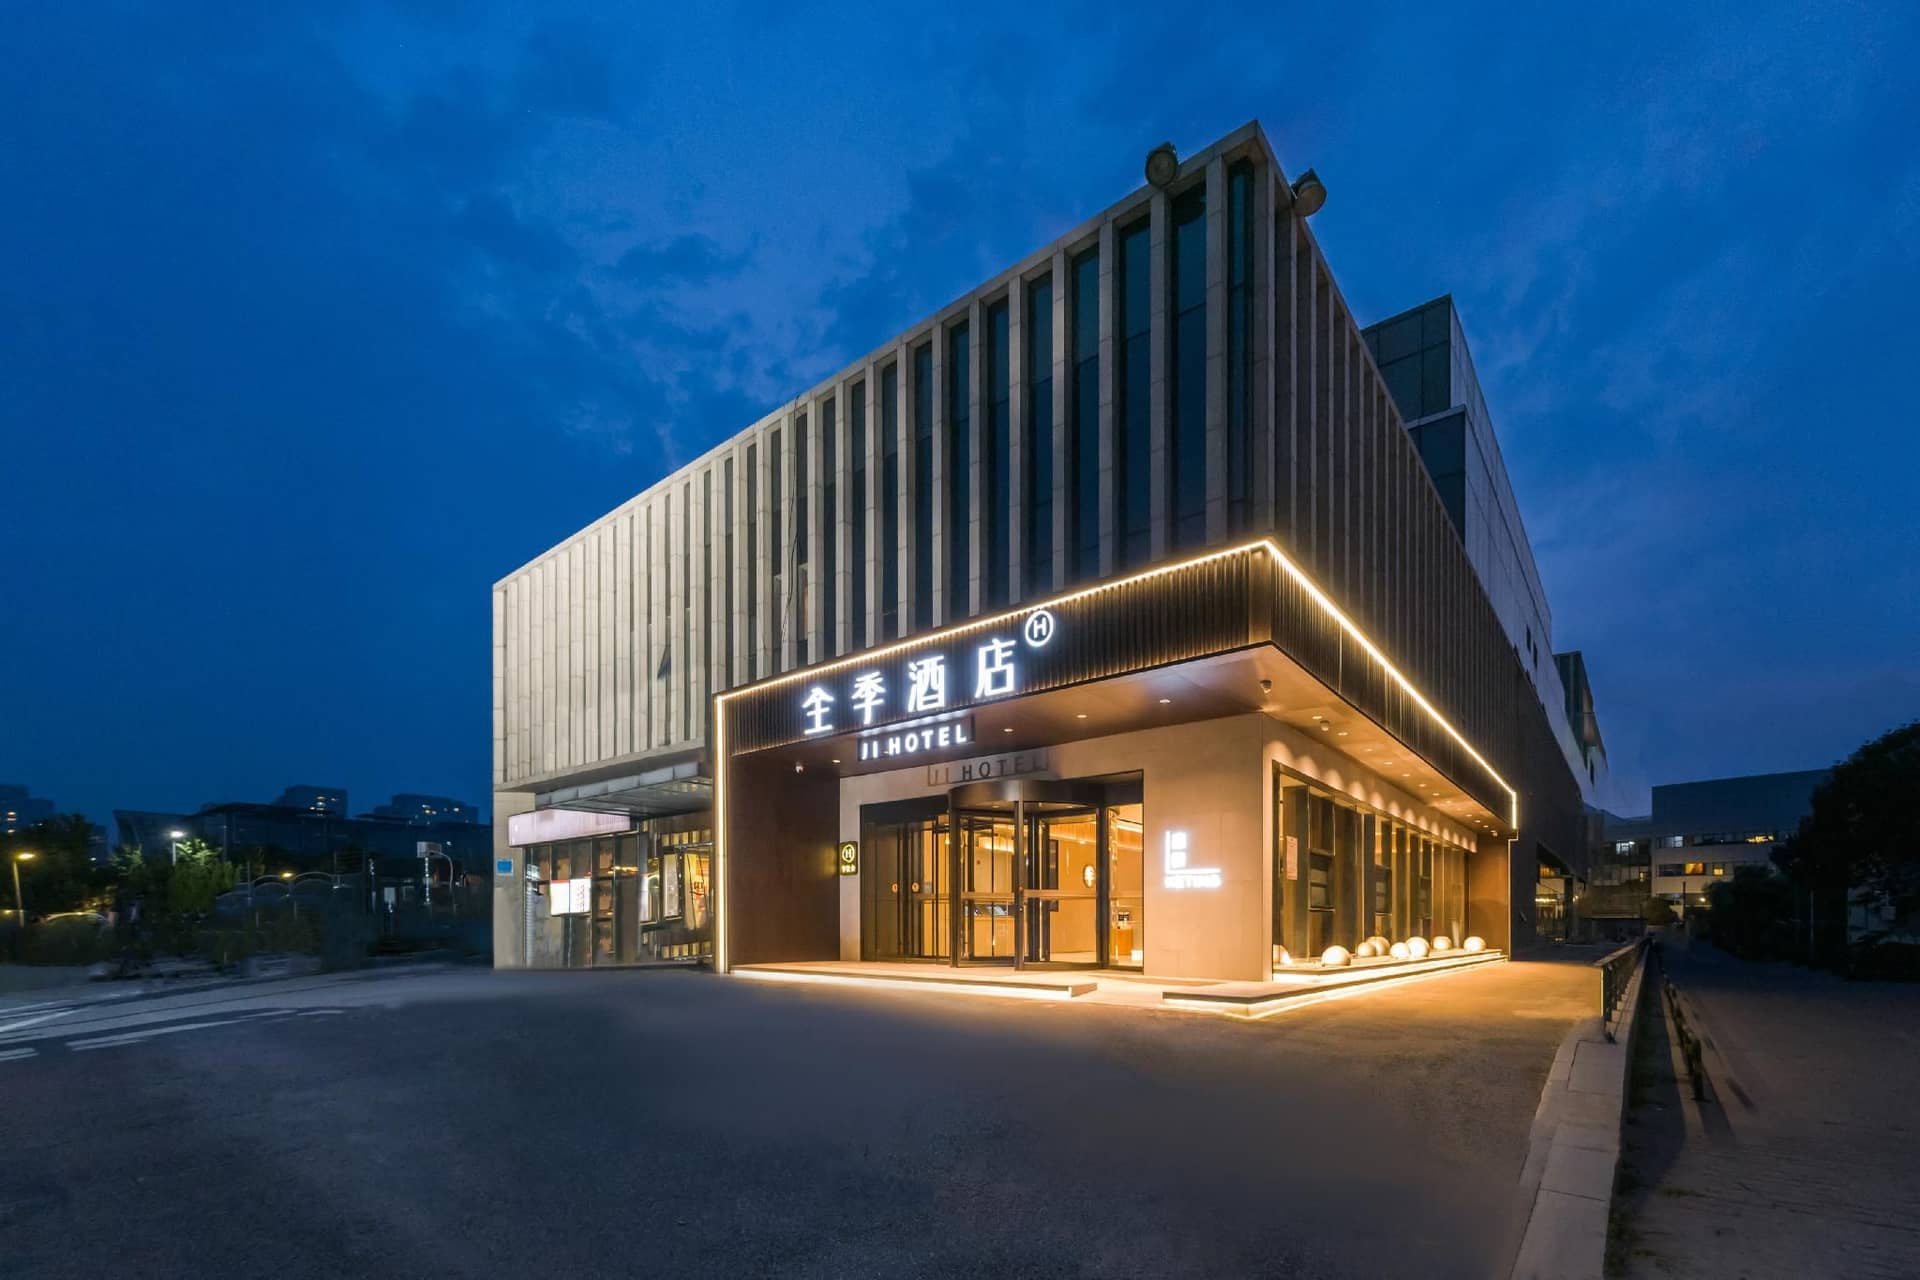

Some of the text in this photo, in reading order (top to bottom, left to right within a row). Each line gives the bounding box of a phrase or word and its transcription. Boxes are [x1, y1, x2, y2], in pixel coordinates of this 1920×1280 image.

[802, 638, 1016, 735] 全季酒店
[861, 724, 967, 760] JI HOTEL
